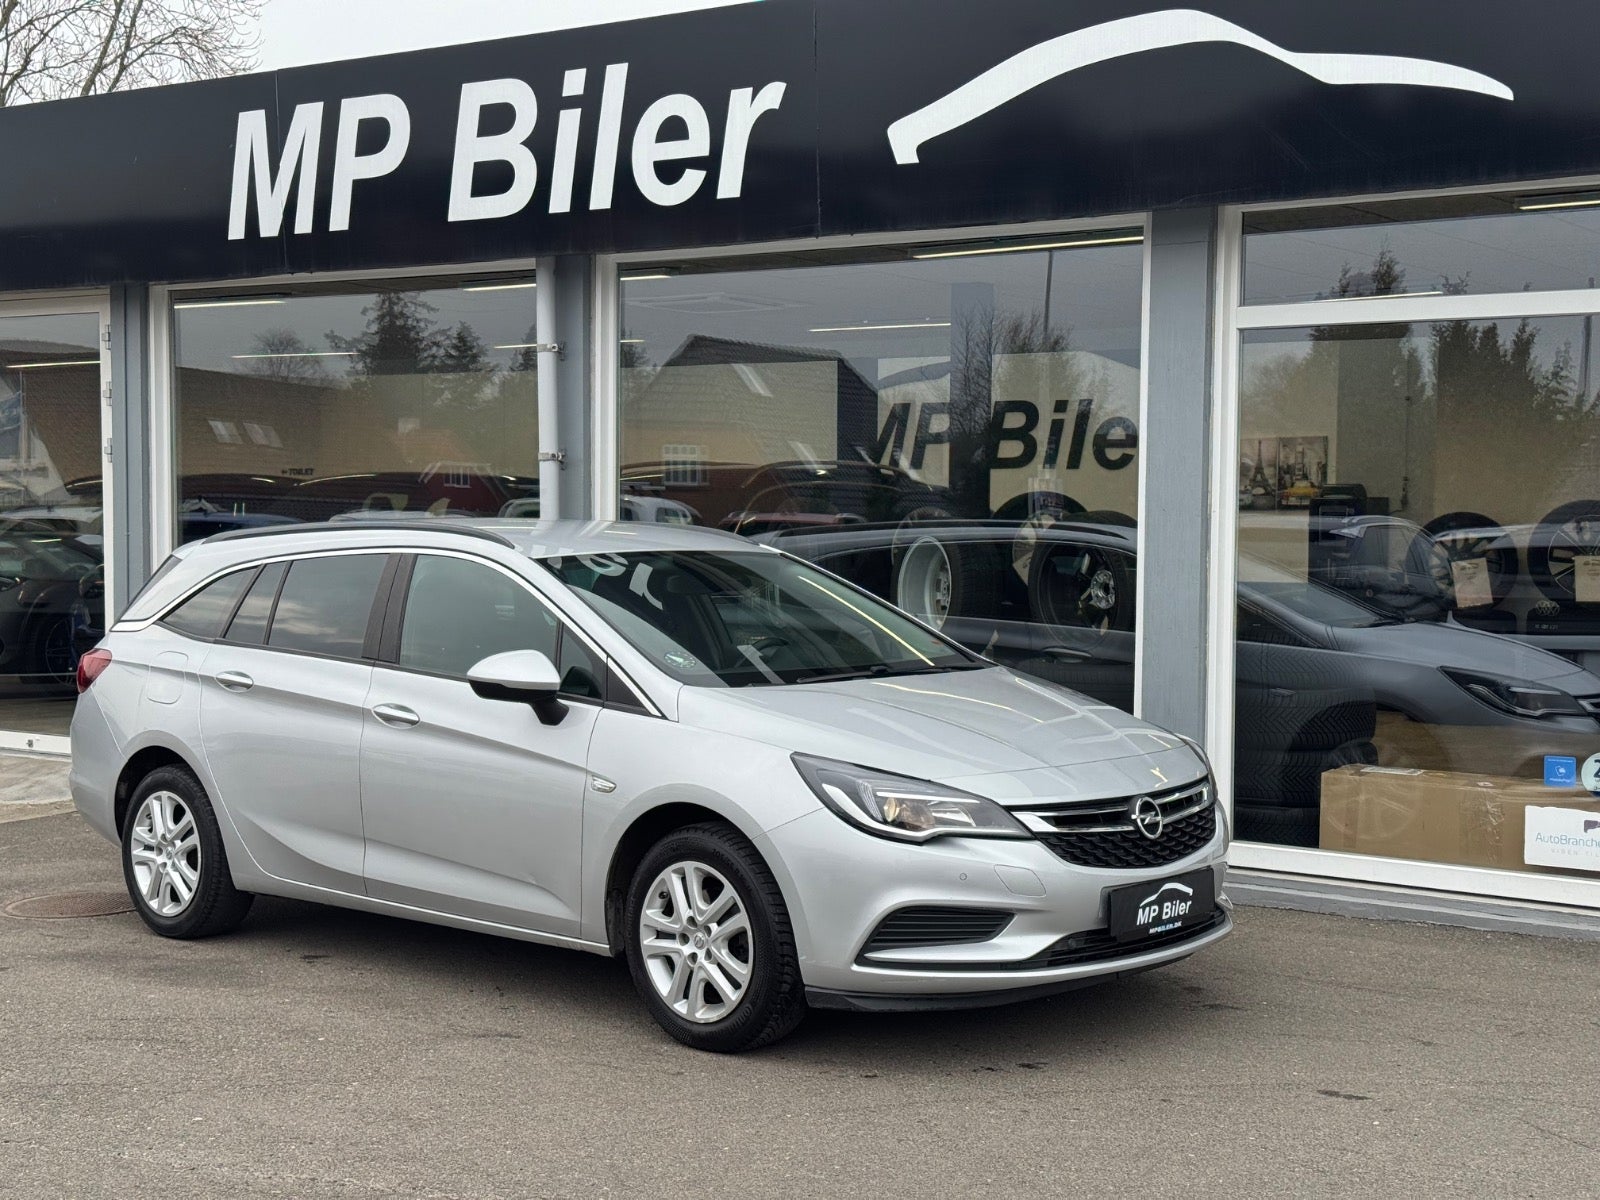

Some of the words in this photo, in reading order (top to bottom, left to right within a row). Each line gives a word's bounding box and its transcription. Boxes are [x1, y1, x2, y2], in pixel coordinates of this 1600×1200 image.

[228, 93, 411, 240] MP
[447, 62, 787, 222] Biler
[1136, 904, 1159, 926] MP
[1162, 899, 1192, 920] Biler
